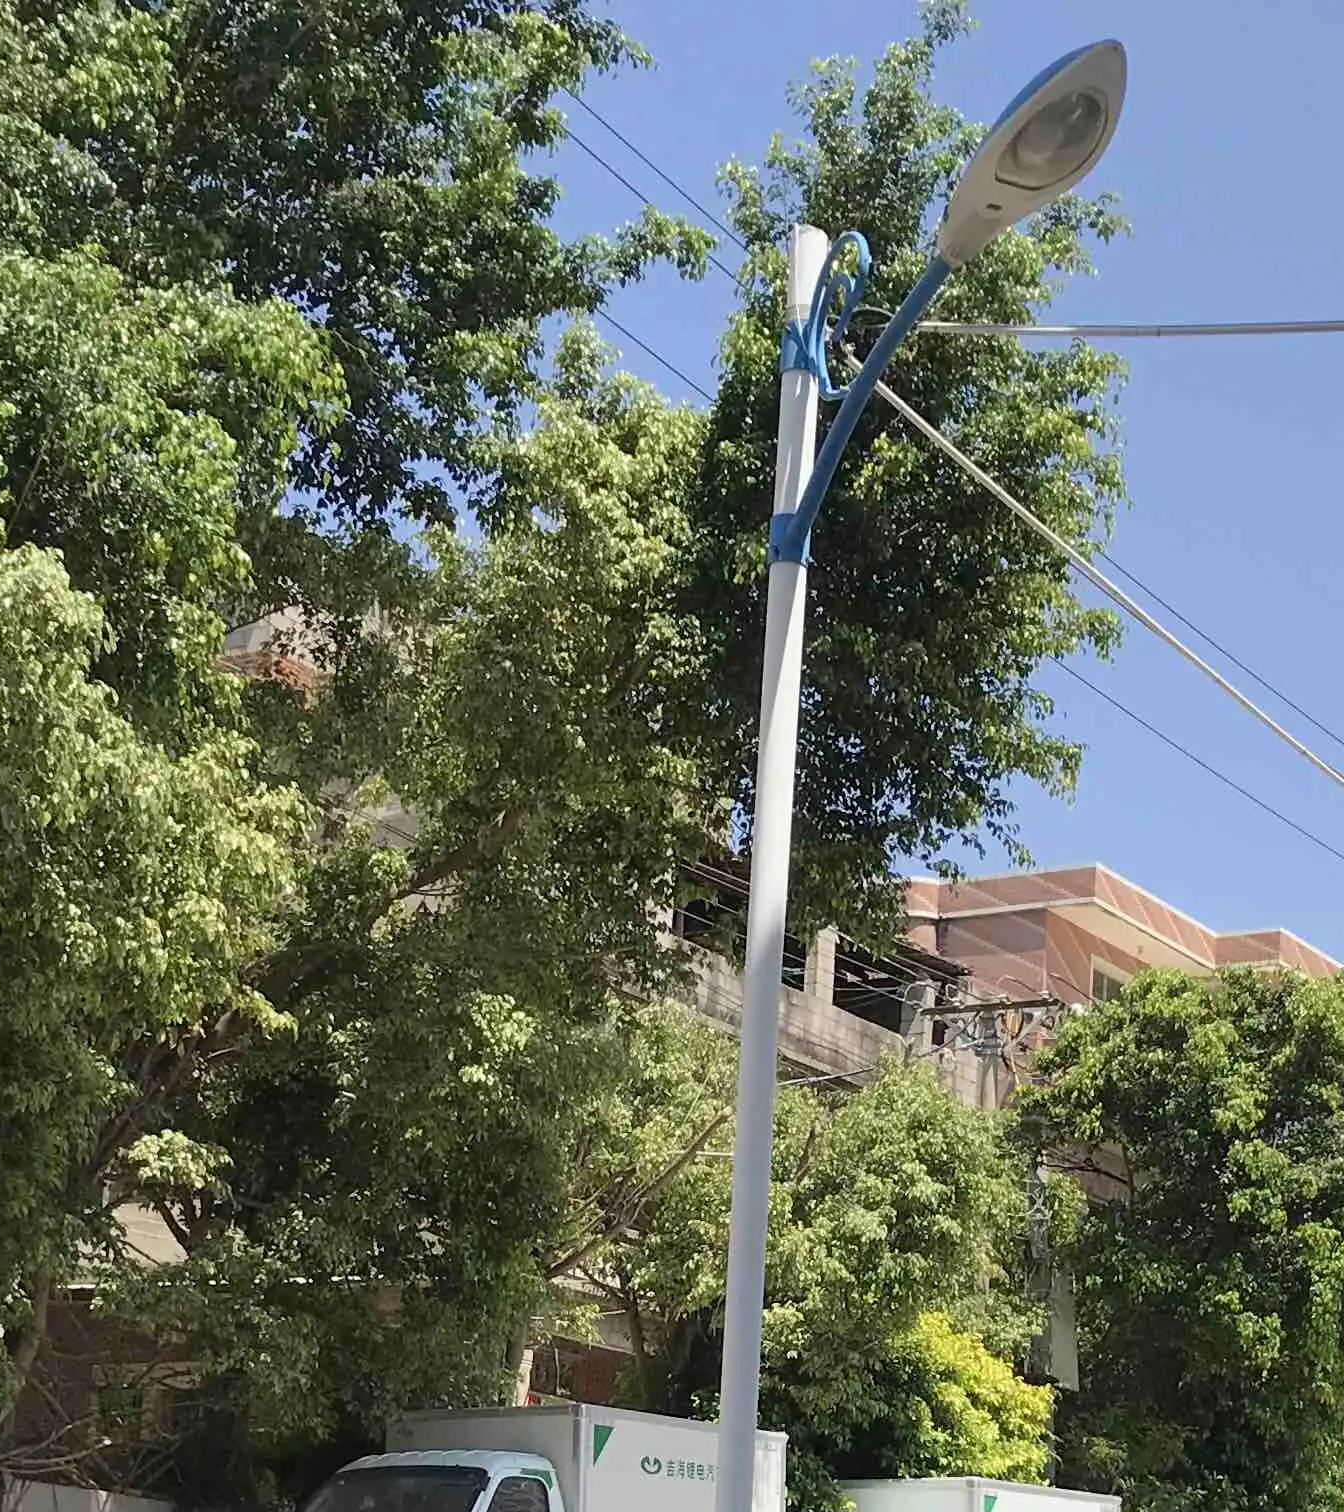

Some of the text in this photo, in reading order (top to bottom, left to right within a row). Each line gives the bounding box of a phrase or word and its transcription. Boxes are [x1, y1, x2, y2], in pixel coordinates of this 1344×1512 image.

[665, 1458, 720, 1481] 吉海锂电汽
